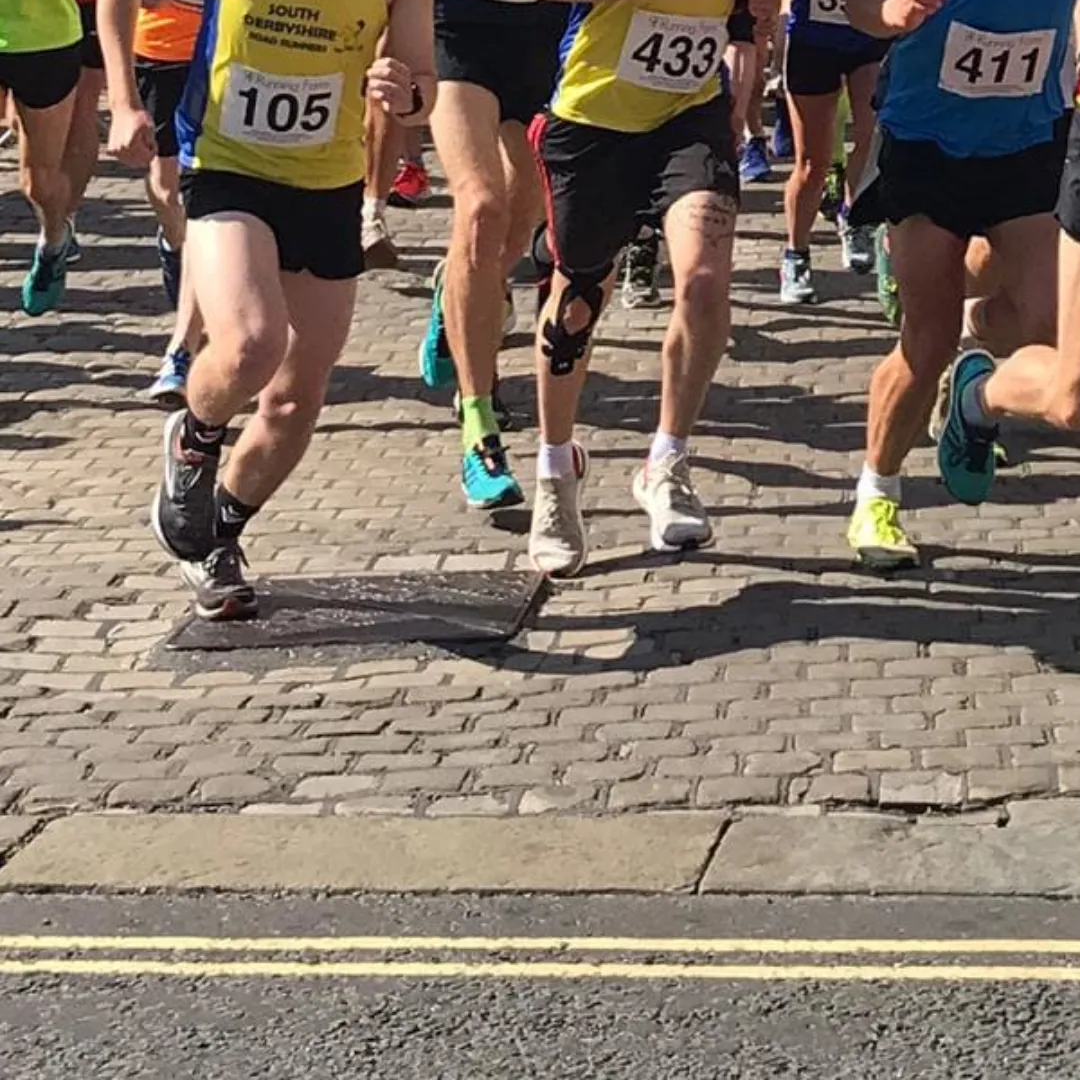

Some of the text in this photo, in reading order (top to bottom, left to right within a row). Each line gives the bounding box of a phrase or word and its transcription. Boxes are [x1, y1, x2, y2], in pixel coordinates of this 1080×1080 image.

[244, 14, 337, 42] DERBYSHIRE
[267, 3, 321, 22] SOUTH
[632, 32, 717, 79] 433
[955, 46, 1039, 84] 411
[238, 86, 332, 133] 105
